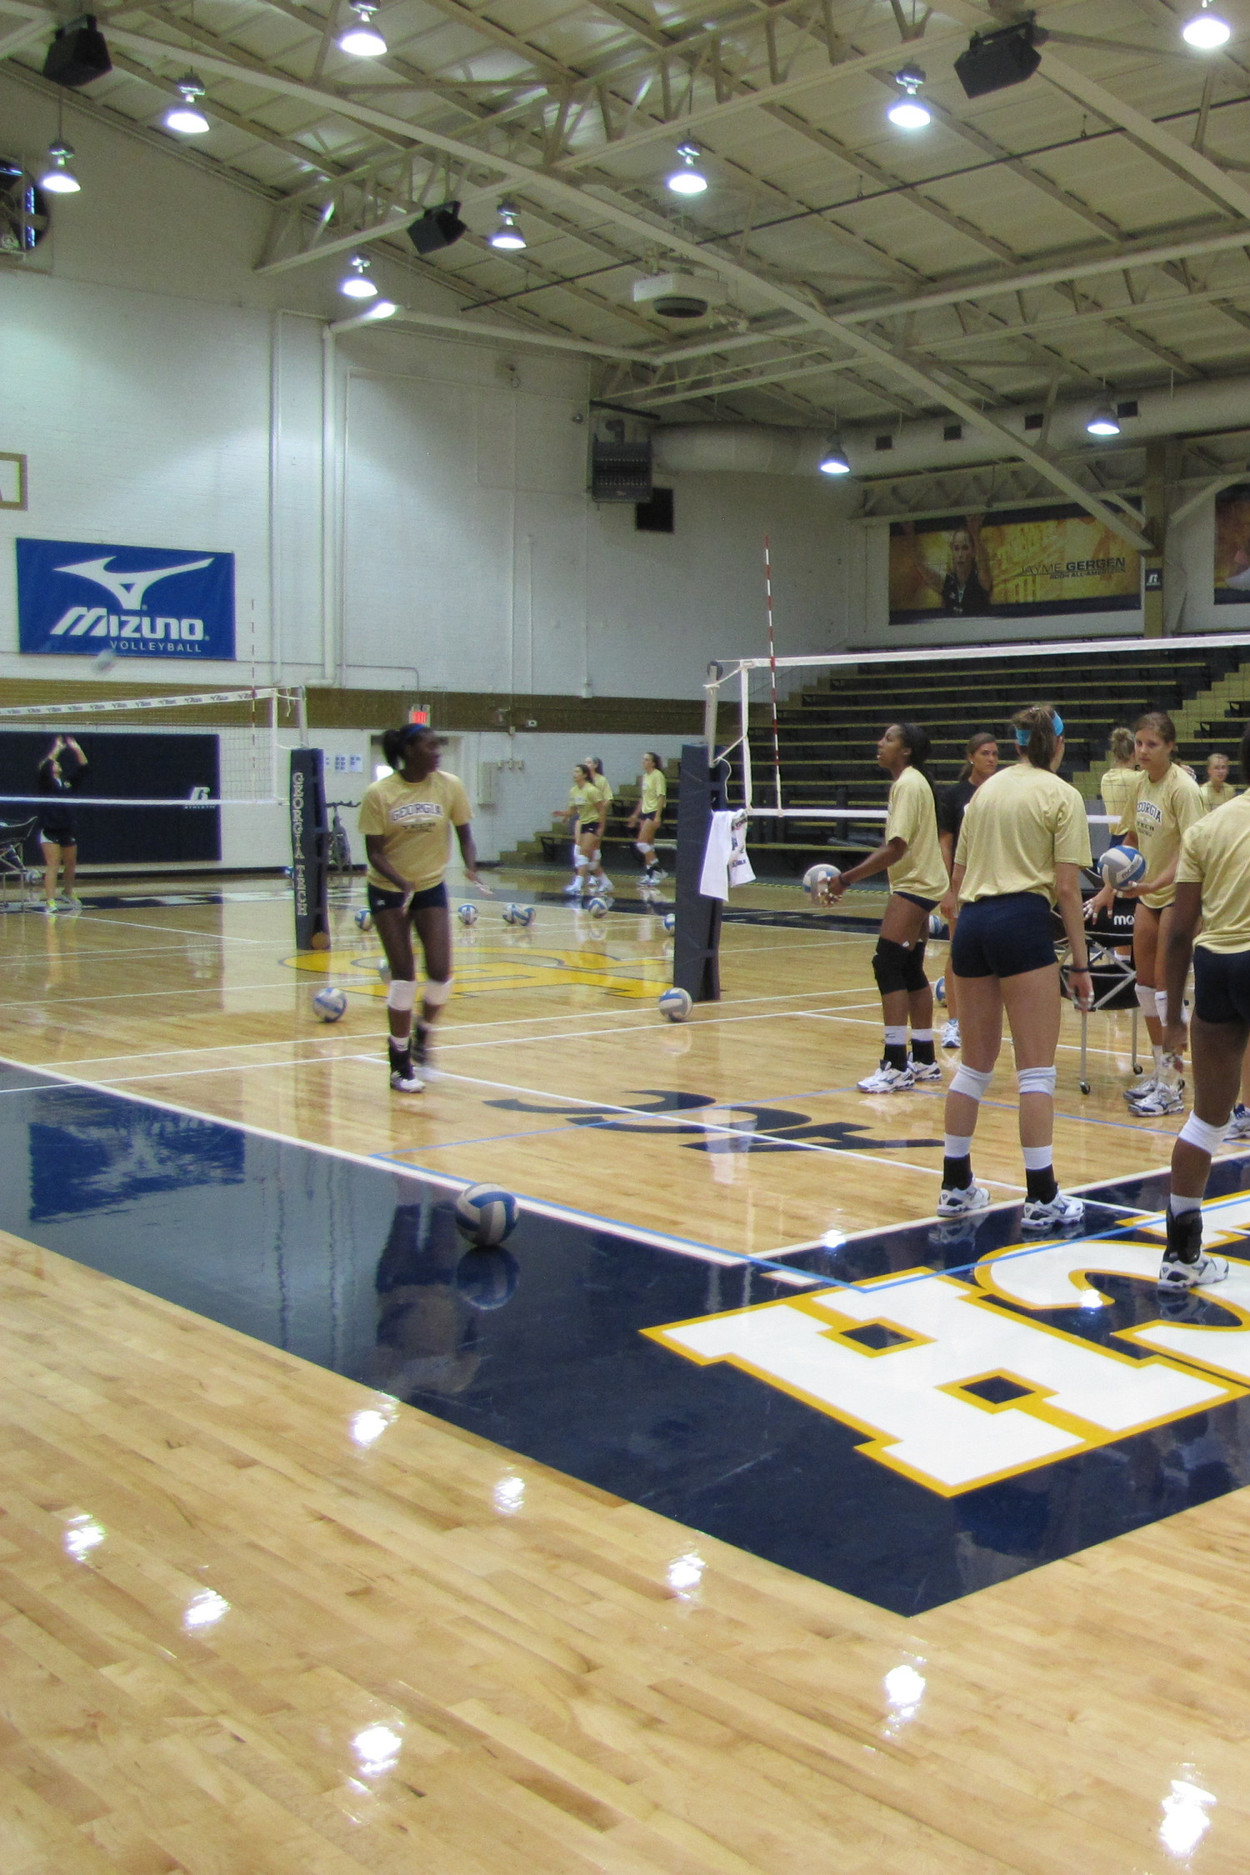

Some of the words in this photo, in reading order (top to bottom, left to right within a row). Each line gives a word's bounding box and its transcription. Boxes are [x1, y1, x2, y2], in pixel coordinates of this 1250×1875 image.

[1066, 557, 1126, 571] GERGEN
[50, 606, 205, 640] MIZUNO
[110, 640, 202, 652] VOLLEYBALL
[293, 772, 305, 859] GEORGIA
[391, 803, 443, 821] GEORGIA
[296, 865, 308, 916] TECH
